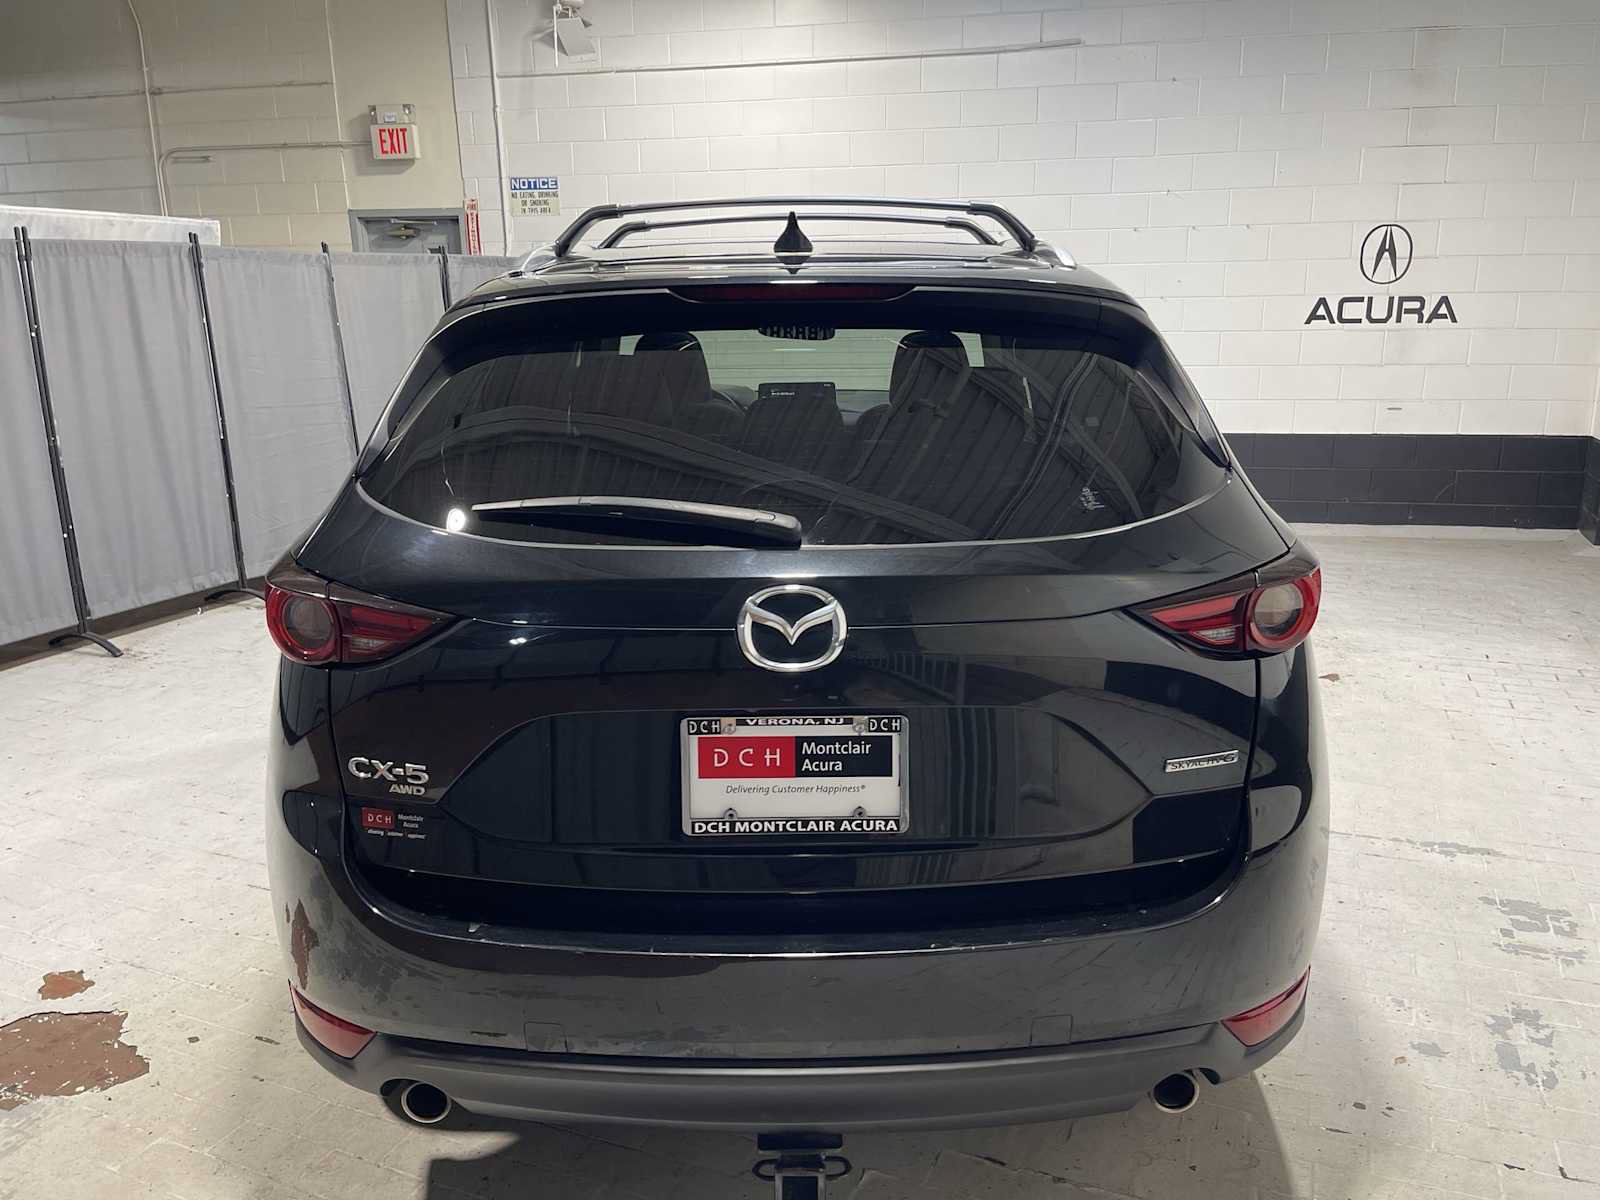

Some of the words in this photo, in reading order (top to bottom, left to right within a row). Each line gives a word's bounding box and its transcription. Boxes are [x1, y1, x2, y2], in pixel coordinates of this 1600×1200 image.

[379, 128, 408, 154] EXIT
[511, 178, 558, 190] NOTICE
[538, 191, 559, 199] DRINKING
[521, 199, 528, 207] OR
[530, 199, 550, 207] SMOKING
[528, 207, 539, 215] THIS
[1304, 295, 1458, 325] ACURA
[689, 720, 721, 735] DCH
[745, 718, 820, 726] VERONA,
[824, 717, 844, 726] NJ
[869, 718, 900, 732] DCH
[802, 741, 872, 755] Montclair
[713, 748, 781, 767] DCH
[348, 757, 429, 784] CX-5
[801, 759, 843, 772] Acura
[389, 783, 426, 796] AWD
[726, 784, 770, 796] Delivering
[772, 785, 814, 794] Customer
[367, 813, 392, 824] DCH
[694, 821, 731, 834] DCH
[734, 819, 836, 833] MONTCLAIR
[839, 819, 898, 832] ACURA
